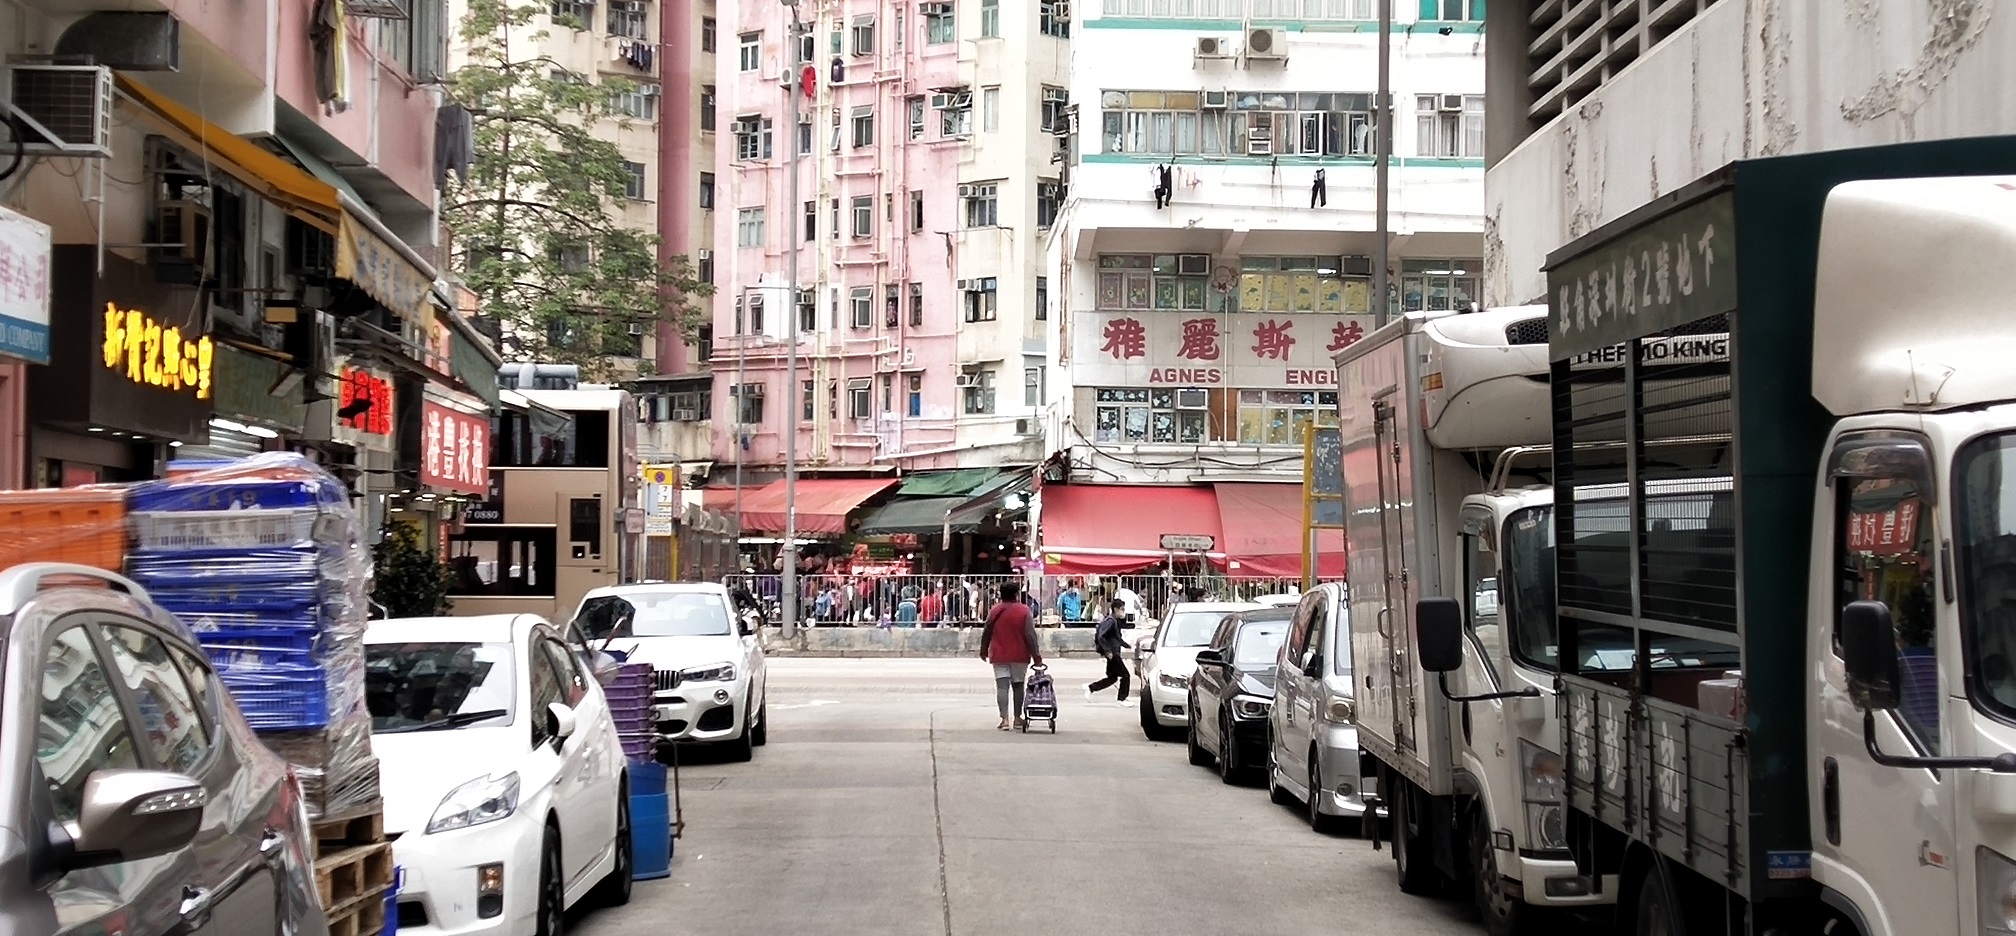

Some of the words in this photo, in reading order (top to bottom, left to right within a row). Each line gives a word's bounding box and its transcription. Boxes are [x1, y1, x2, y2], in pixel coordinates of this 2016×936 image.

[1674, 339, 1725, 358] KING
[1149, 368, 1221, 383] AGNES
[1286, 369, 1338, 385] ENGL
